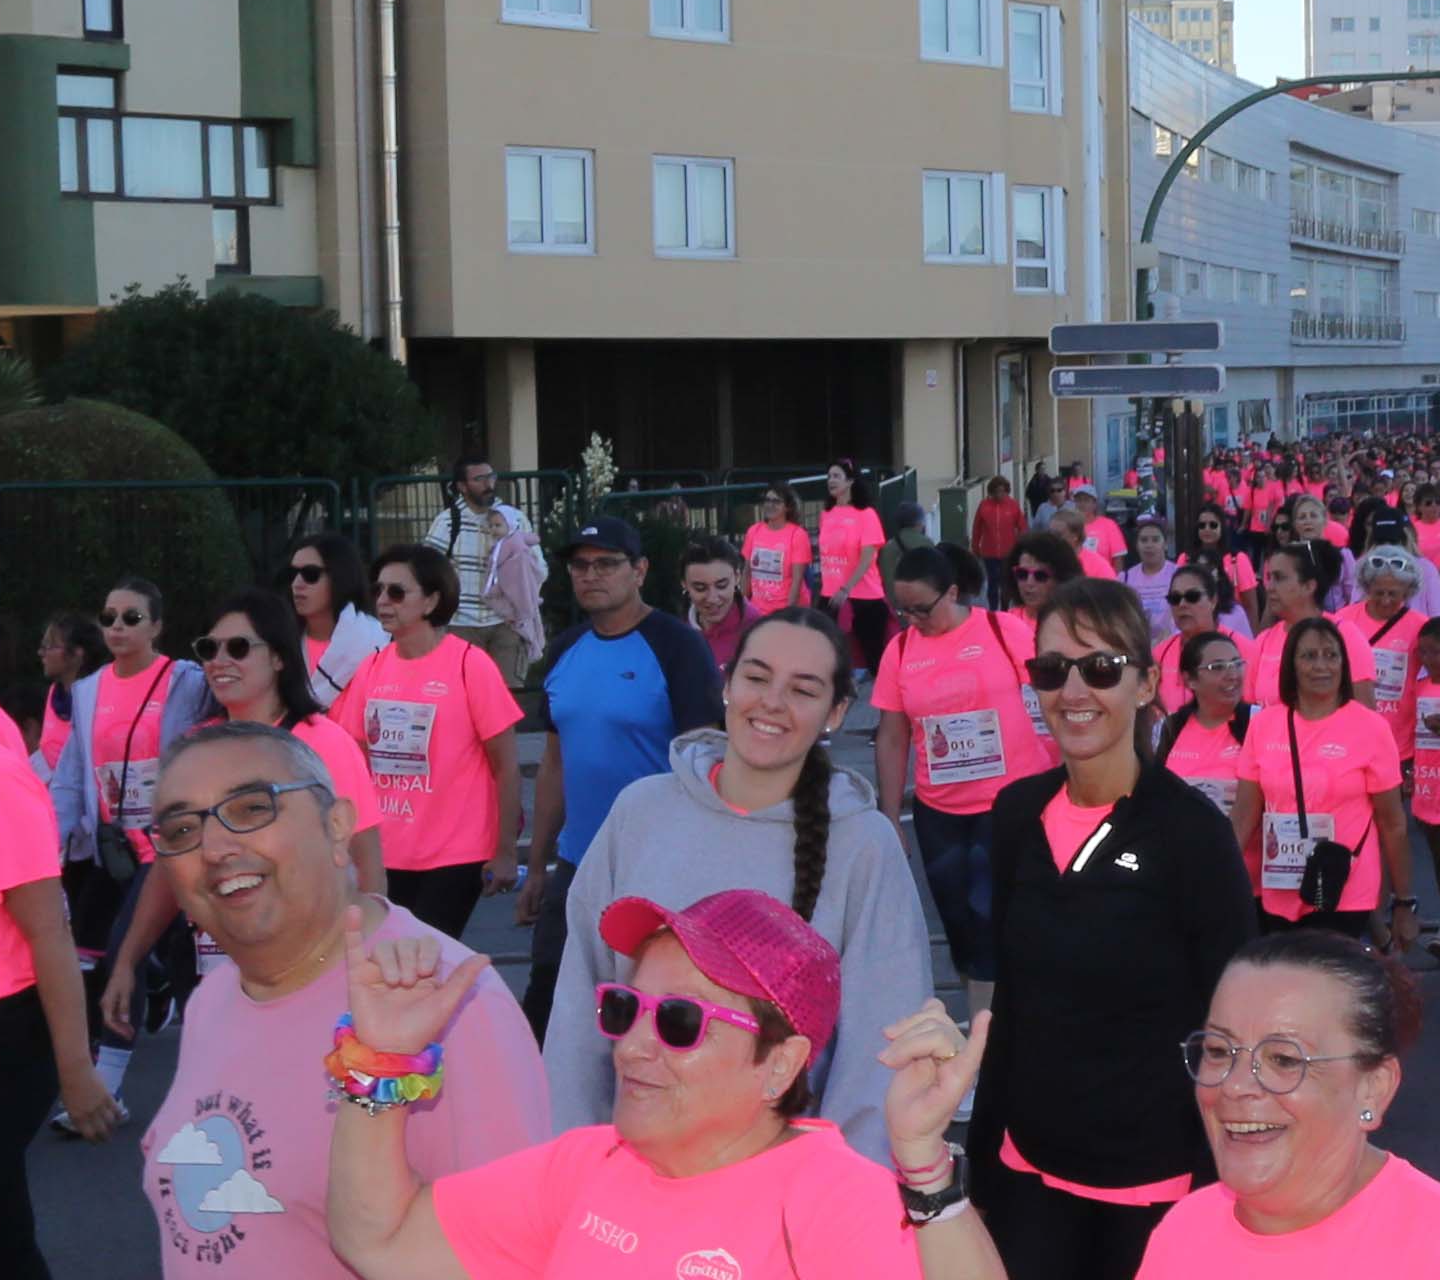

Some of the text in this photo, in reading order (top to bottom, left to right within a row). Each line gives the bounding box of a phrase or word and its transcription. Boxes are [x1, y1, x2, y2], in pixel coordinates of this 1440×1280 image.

[1024, 700, 1038, 709] 01
[1376, 702, 1398, 713] SAL
[382, 729, 404, 742] 016
[951, 739, 975, 751] 016
[377, 795, 413, 816] UMA
